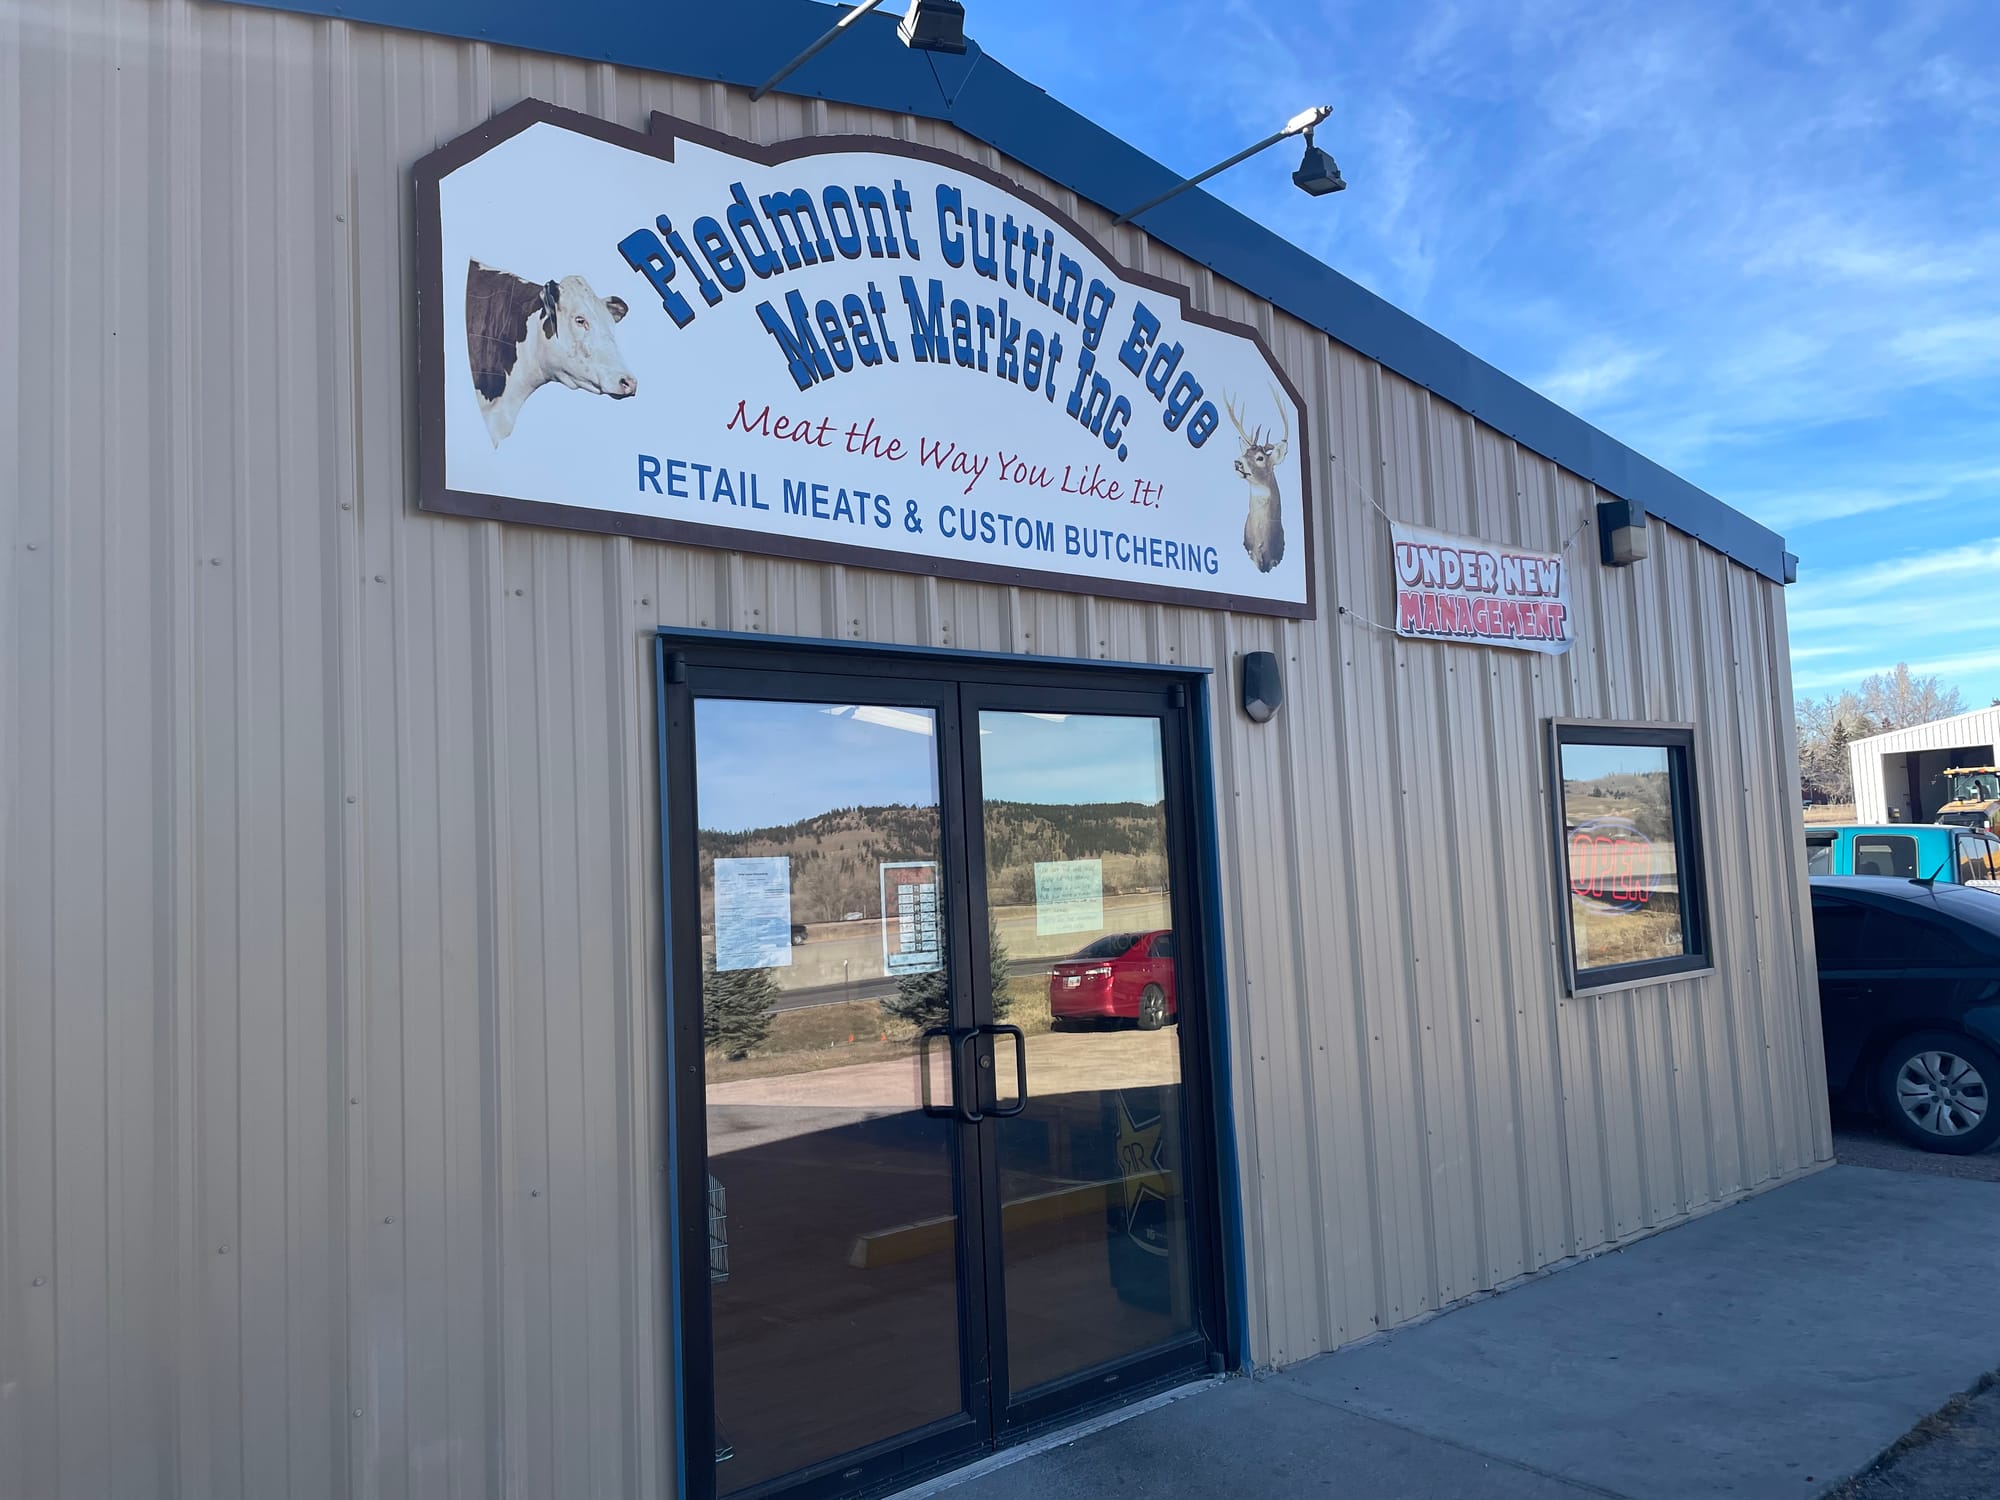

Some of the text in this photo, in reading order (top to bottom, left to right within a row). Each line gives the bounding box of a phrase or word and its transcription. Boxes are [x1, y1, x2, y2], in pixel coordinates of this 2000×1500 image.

[617, 179, 1219, 448] Piedmont Cutting Edge
[755, 275, 1132, 462] Meat Market Inc.
[727, 400, 1163, 509] Meat the Way You Like It!
[638, 454, 1219, 575] RETAIL MEATS & CUSTOM BUTCHERING
[1395, 542, 1561, 598] UNDER NEW
[1397, 591, 1567, 641] MANAGEMENT
[1571, 834, 1650, 903] OPEN
